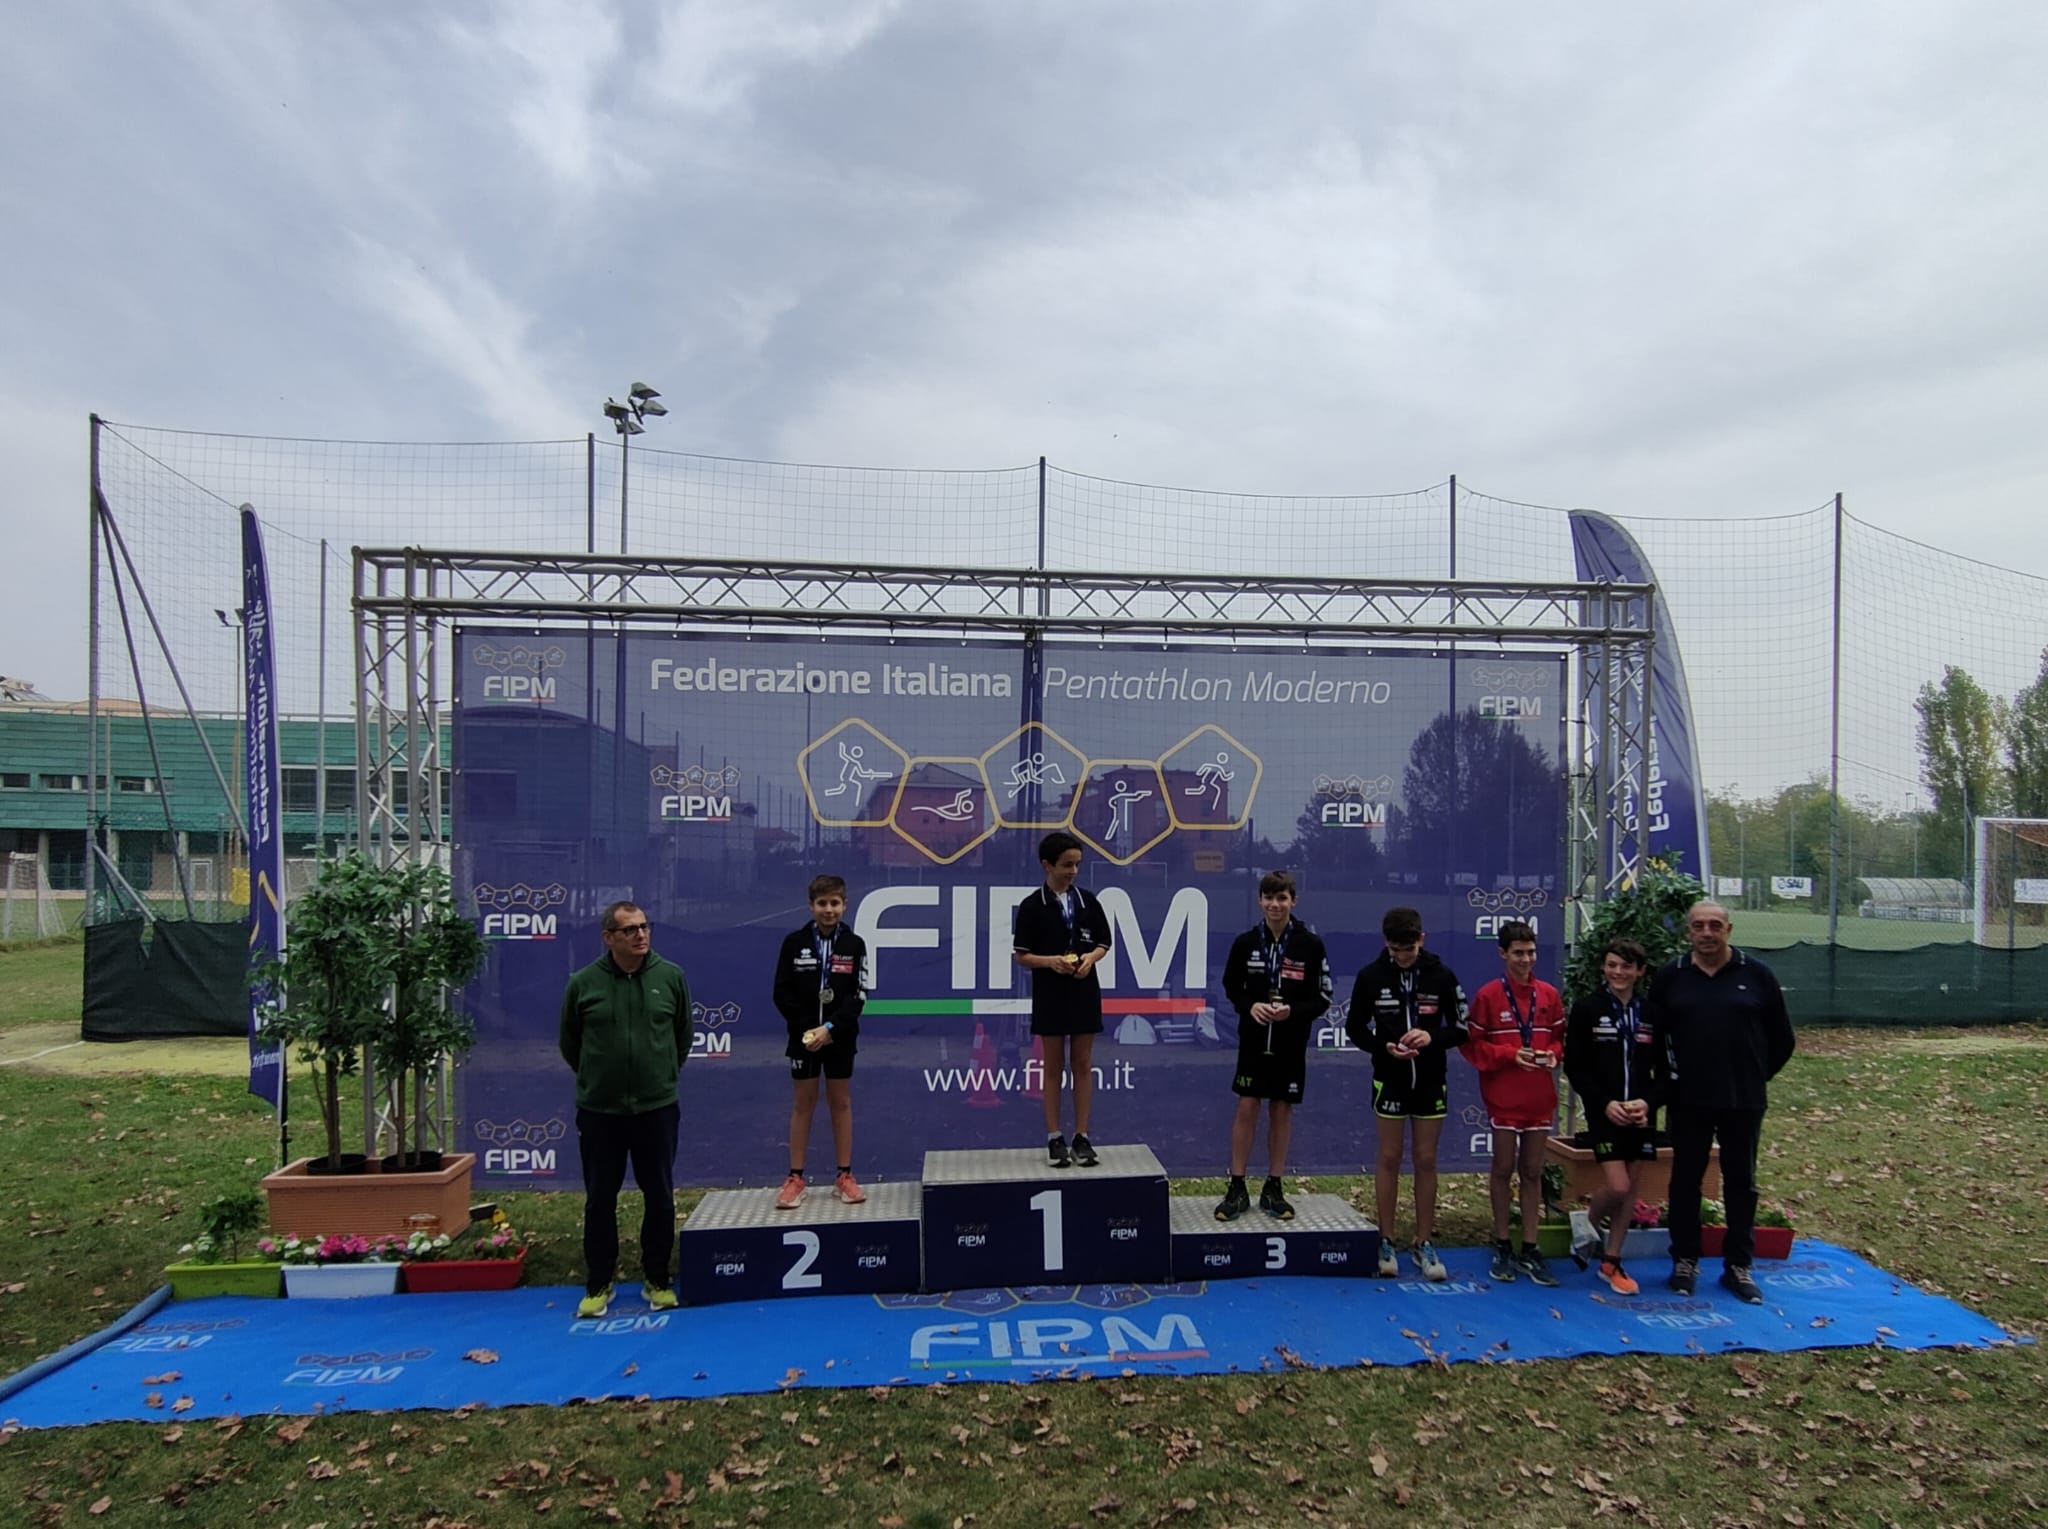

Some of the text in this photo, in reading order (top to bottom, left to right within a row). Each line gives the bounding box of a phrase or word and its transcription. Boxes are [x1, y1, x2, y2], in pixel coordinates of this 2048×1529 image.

[484, 676, 556, 698] FIPM
[651, 658, 1391, 704] Federazione Italiana Pentathlon Moderno
[1480, 696, 1541, 716] FIPM
[660, 796, 731, 817] FIPM
[1321, 802, 1386, 823] FIPM
[483, 914, 557, 935] FIPM
[690, 1031, 731, 1052] PM
[1470, 1133, 1494, 1152] FI
[485, 1150, 556, 1170] FIPM
[1030, 1189, 1064, 1271] 1
[1110, 1228, 1138, 1240] FIPM
[957, 1234, 986, 1247] FIPM
[781, 1230, 822, 1290] 2
[858, 1256, 887, 1268] FIPM
[1204, 1254, 1231, 1266] FIPM
[1264, 1237, 1287, 1269] 3
[1321, 1252, 1347, 1264] FIPM
[715, 1263, 745, 1275] FIPM
[1764, 1273, 1851, 1289] FIPM
[569, 1314, 670, 1333] FIPM
[1636, 1311, 1734, 1328] FIPM
[100, 1334, 213, 1351] FIPM
[910, 1313, 1206, 1359] FIPM
[284, 1366, 405, 1383] FIPM
